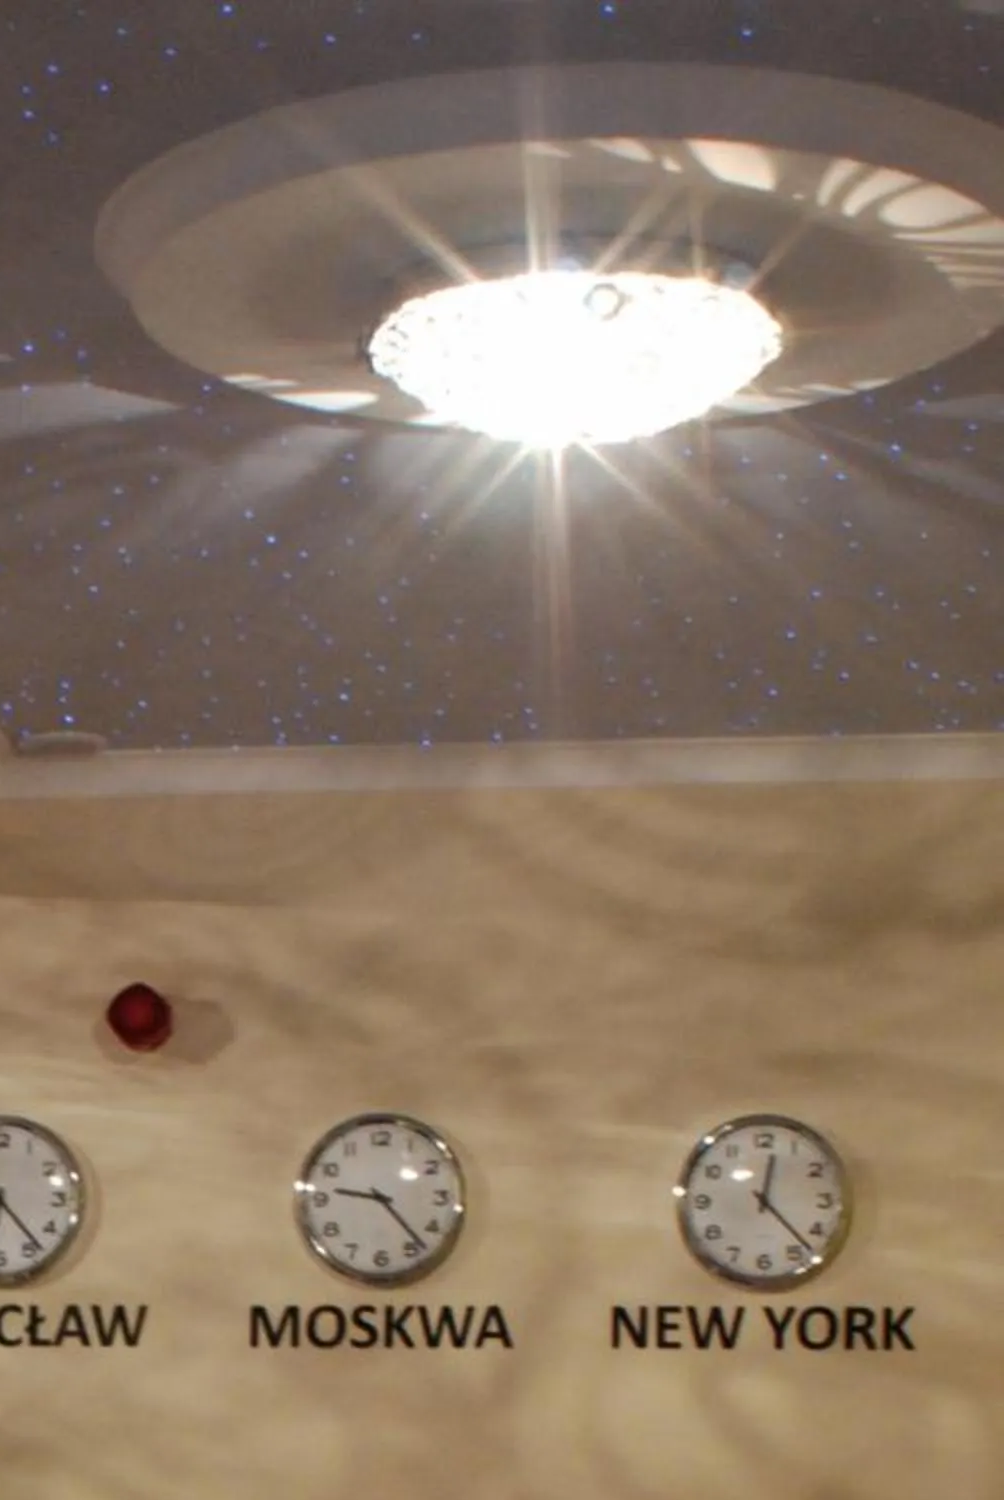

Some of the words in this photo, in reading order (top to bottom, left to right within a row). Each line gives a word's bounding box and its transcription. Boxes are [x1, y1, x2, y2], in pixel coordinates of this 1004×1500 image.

[370, 1131, 392, 1146] 12
[754, 1133, 775, 1148] 12
[323, 1163, 339, 1177] 10
[424, 1160, 440, 1174] 2
[704, 1165, 722, 1180] 10
[806, 1163, 824, 1178] 2
[51, 1192, 66, 1207] 3
[313, 1192, 328, 1207] 9
[434, 1190, 449, 1205] 3
[695, 1194, 711, 1209] 9
[816, 1193, 833, 1209] 3
[43, 1221, 57, 1233] 4
[323, 1222, 340, 1236] 8
[424, 1219, 439, 1232] 4
[704, 1225, 722, 1240] 8
[809, 1222, 824, 1236] 4
[344, 1243, 359, 1259] 7
[373, 1251, 389, 1266] 6
[726, 1247, 741, 1262] 7
[756, 1254, 773, 1269] 6
[249, 1303, 514, 1349] MOSKWA
[611, 1304, 746, 1350] NEW
[763, 1304, 917, 1352] YORK
